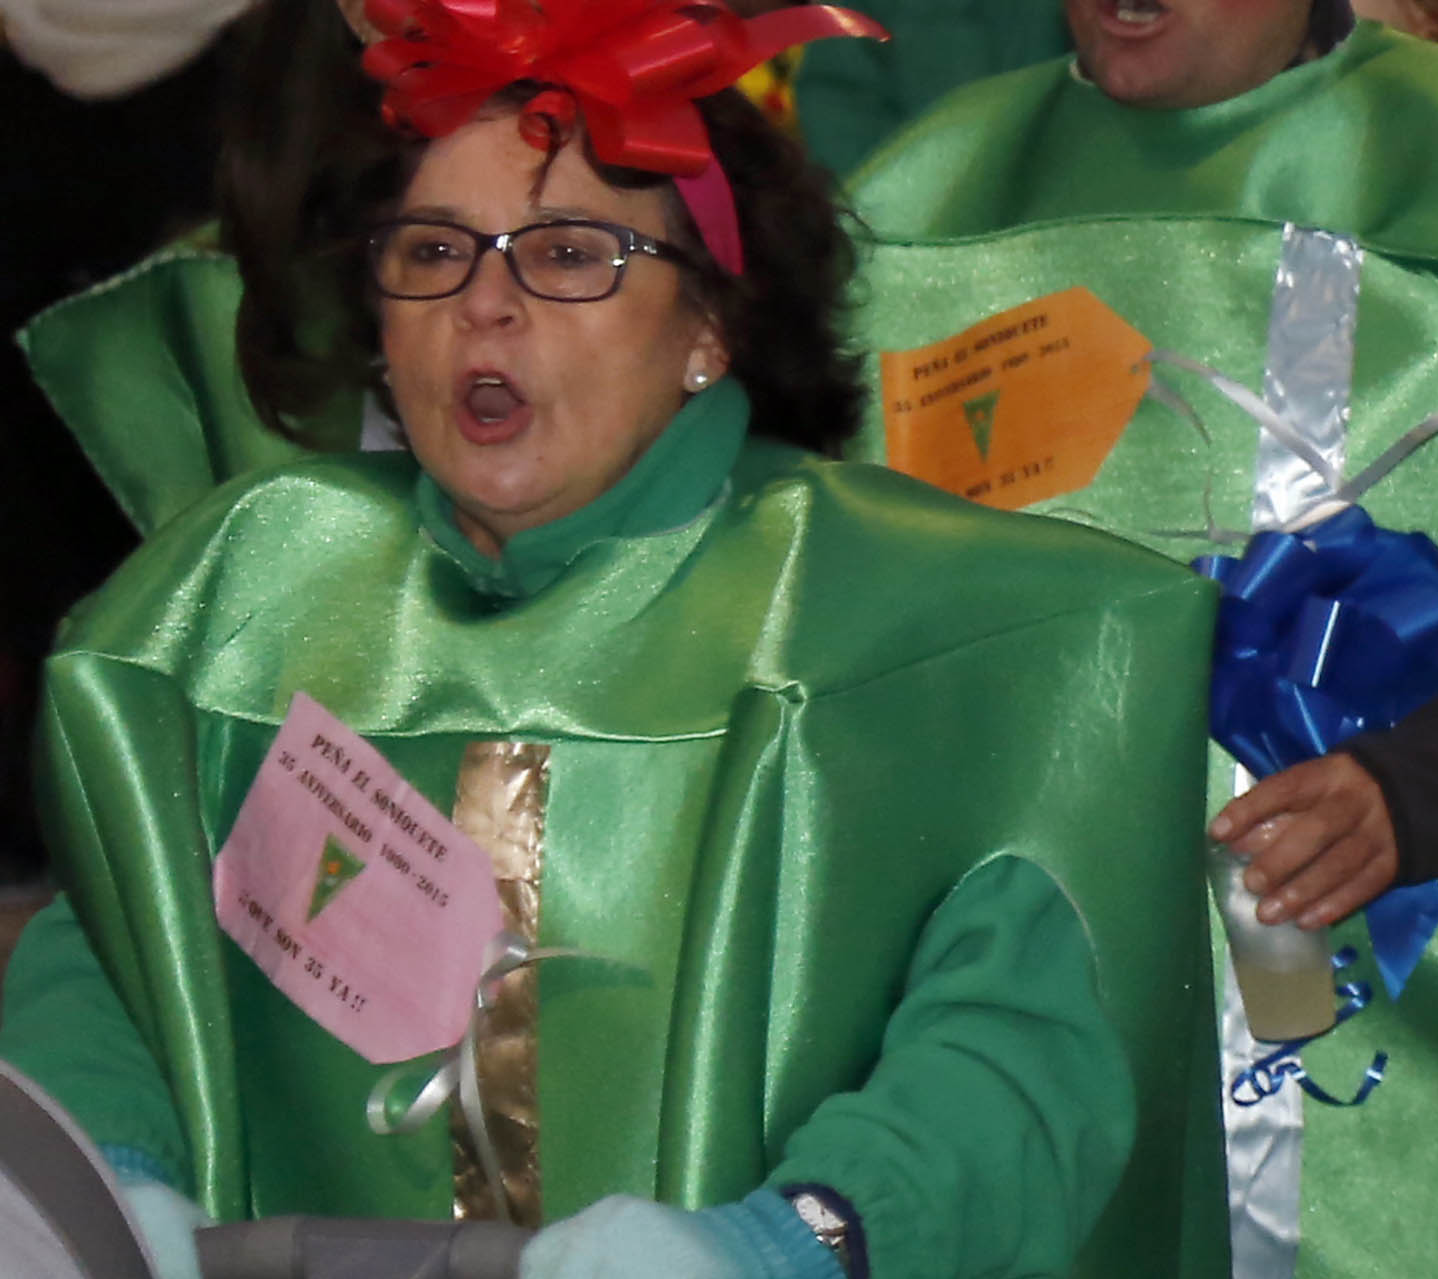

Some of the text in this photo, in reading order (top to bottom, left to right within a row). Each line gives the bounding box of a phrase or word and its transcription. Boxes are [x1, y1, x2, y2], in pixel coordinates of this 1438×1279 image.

[277, 750, 296, 772] 35
[296, 769, 373, 843] ANIVERSARIO
[310, 733, 448, 859] PEÑA EL SONIQUETE
[272, 927, 302, 960] SON
[304, 956, 324, 980] 35
